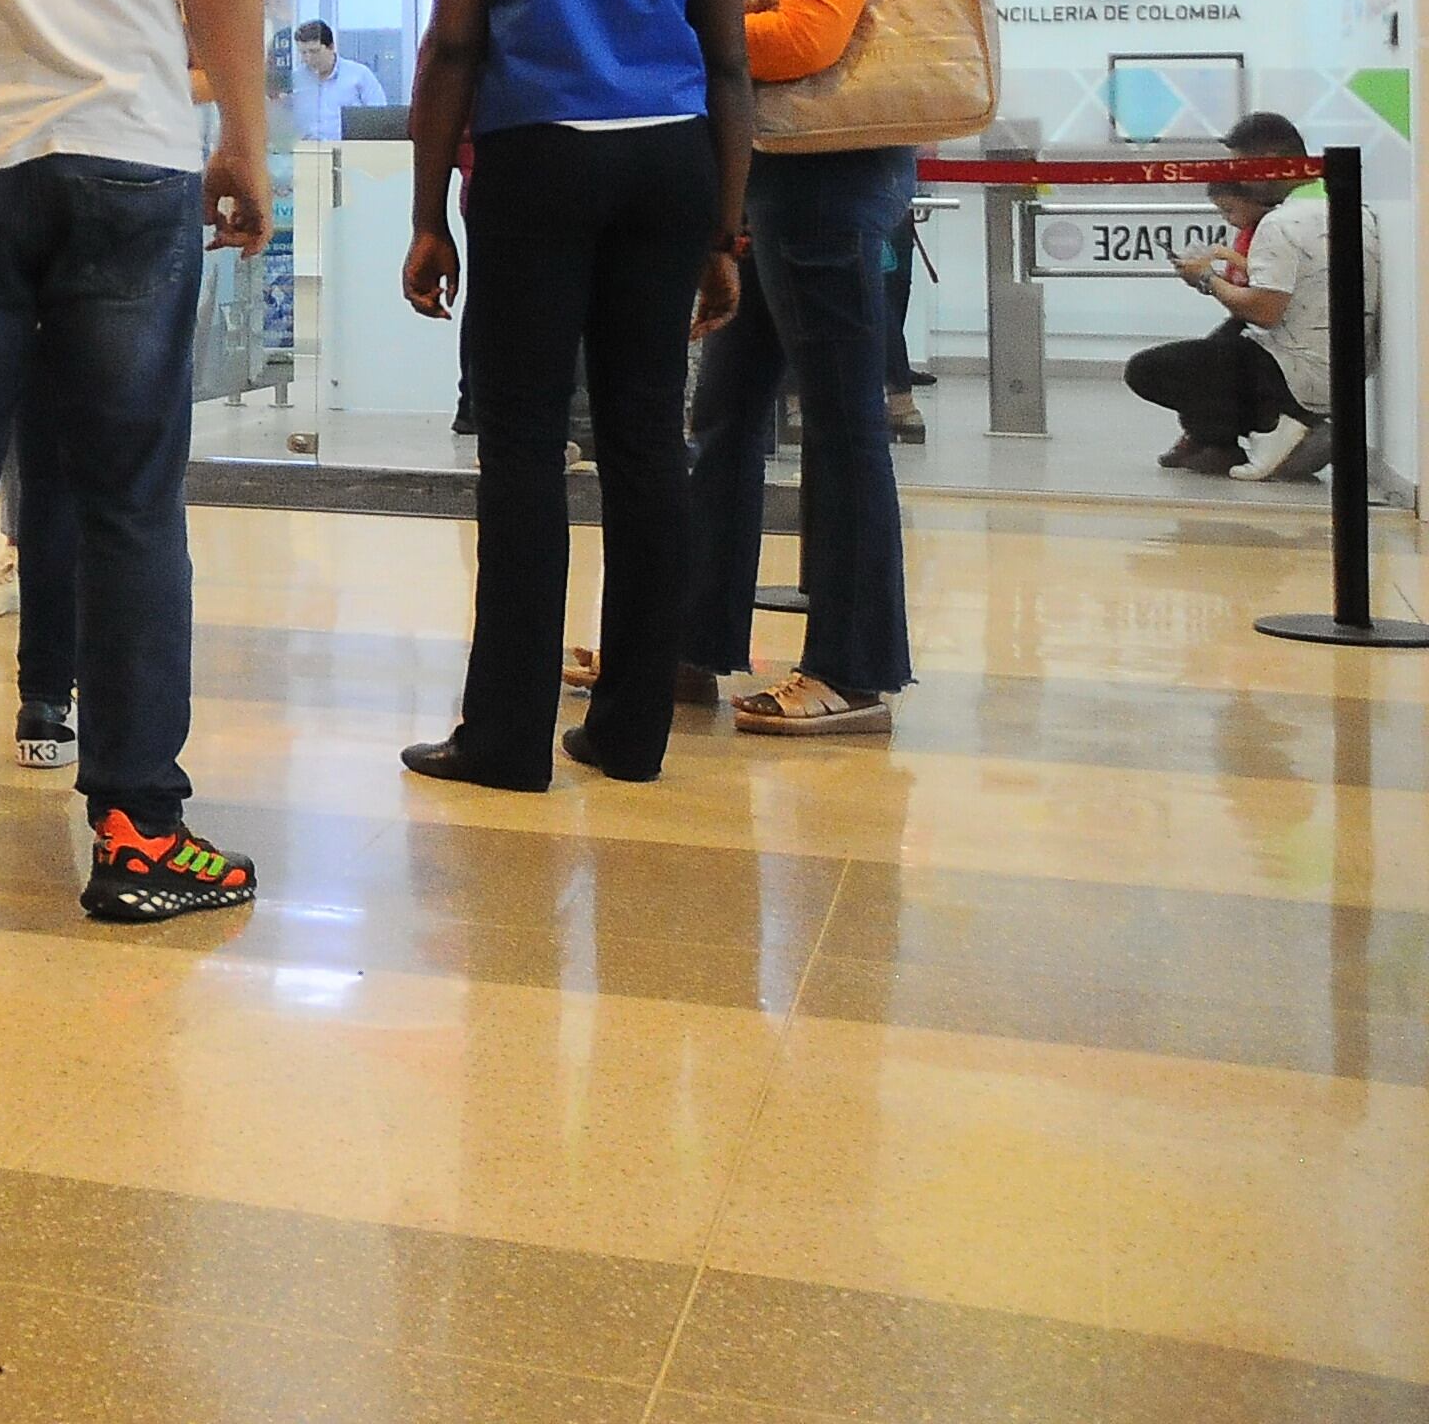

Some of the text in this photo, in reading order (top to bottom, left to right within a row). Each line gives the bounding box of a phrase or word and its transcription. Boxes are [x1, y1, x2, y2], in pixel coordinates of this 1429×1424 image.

[996, 3, 1241, 22] NCILLERIA DE COLOMBIA
